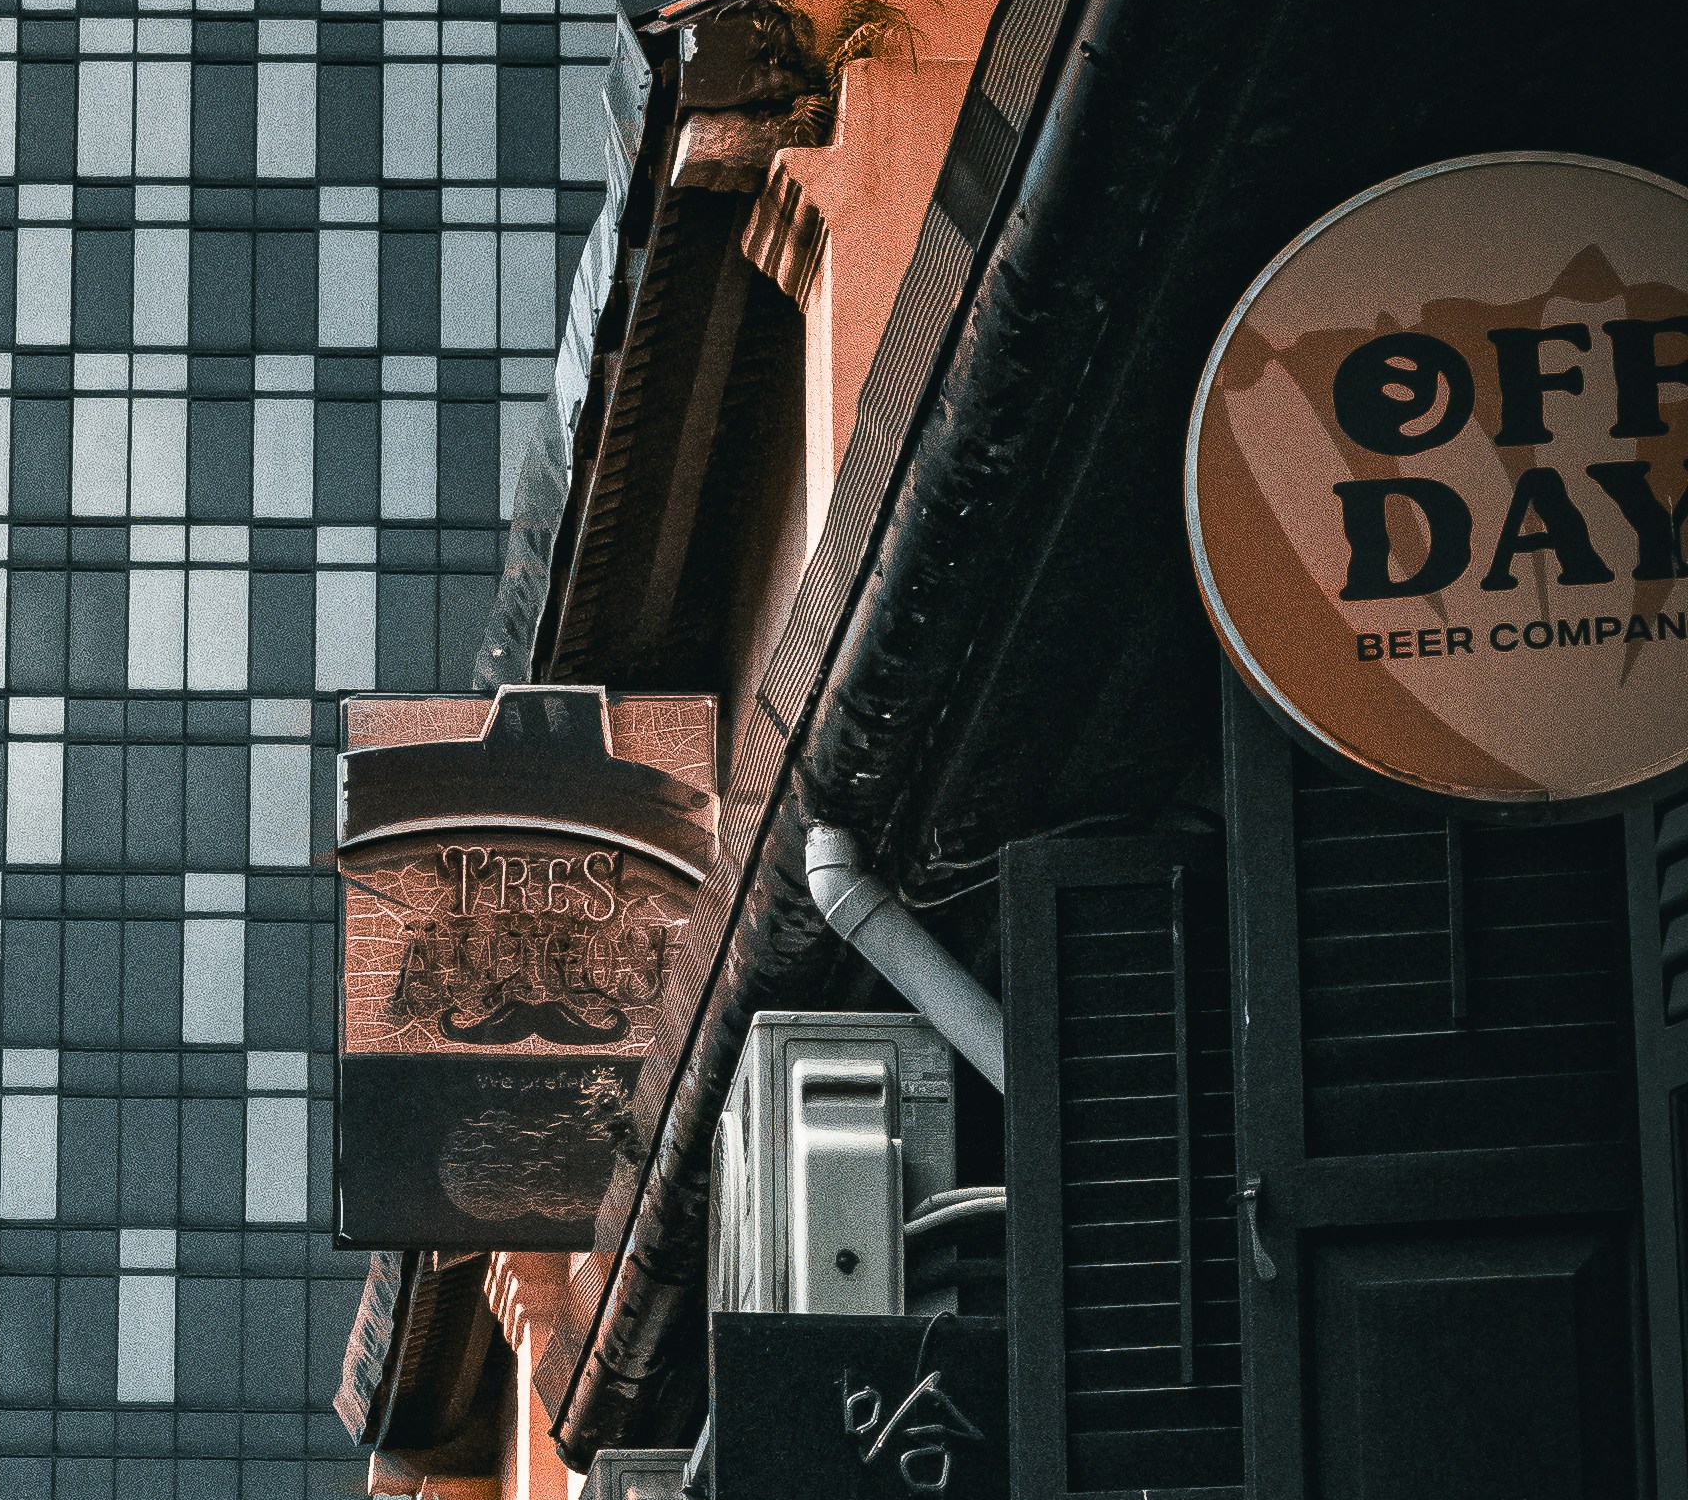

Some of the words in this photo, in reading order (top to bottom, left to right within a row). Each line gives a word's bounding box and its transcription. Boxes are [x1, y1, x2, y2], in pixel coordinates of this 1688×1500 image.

[1332, 316, 1688, 457] OFF
[1332, 459, 1688, 601] DAY
[1356, 626, 1475, 663] BEER
[436, 844, 622, 922] TRES
